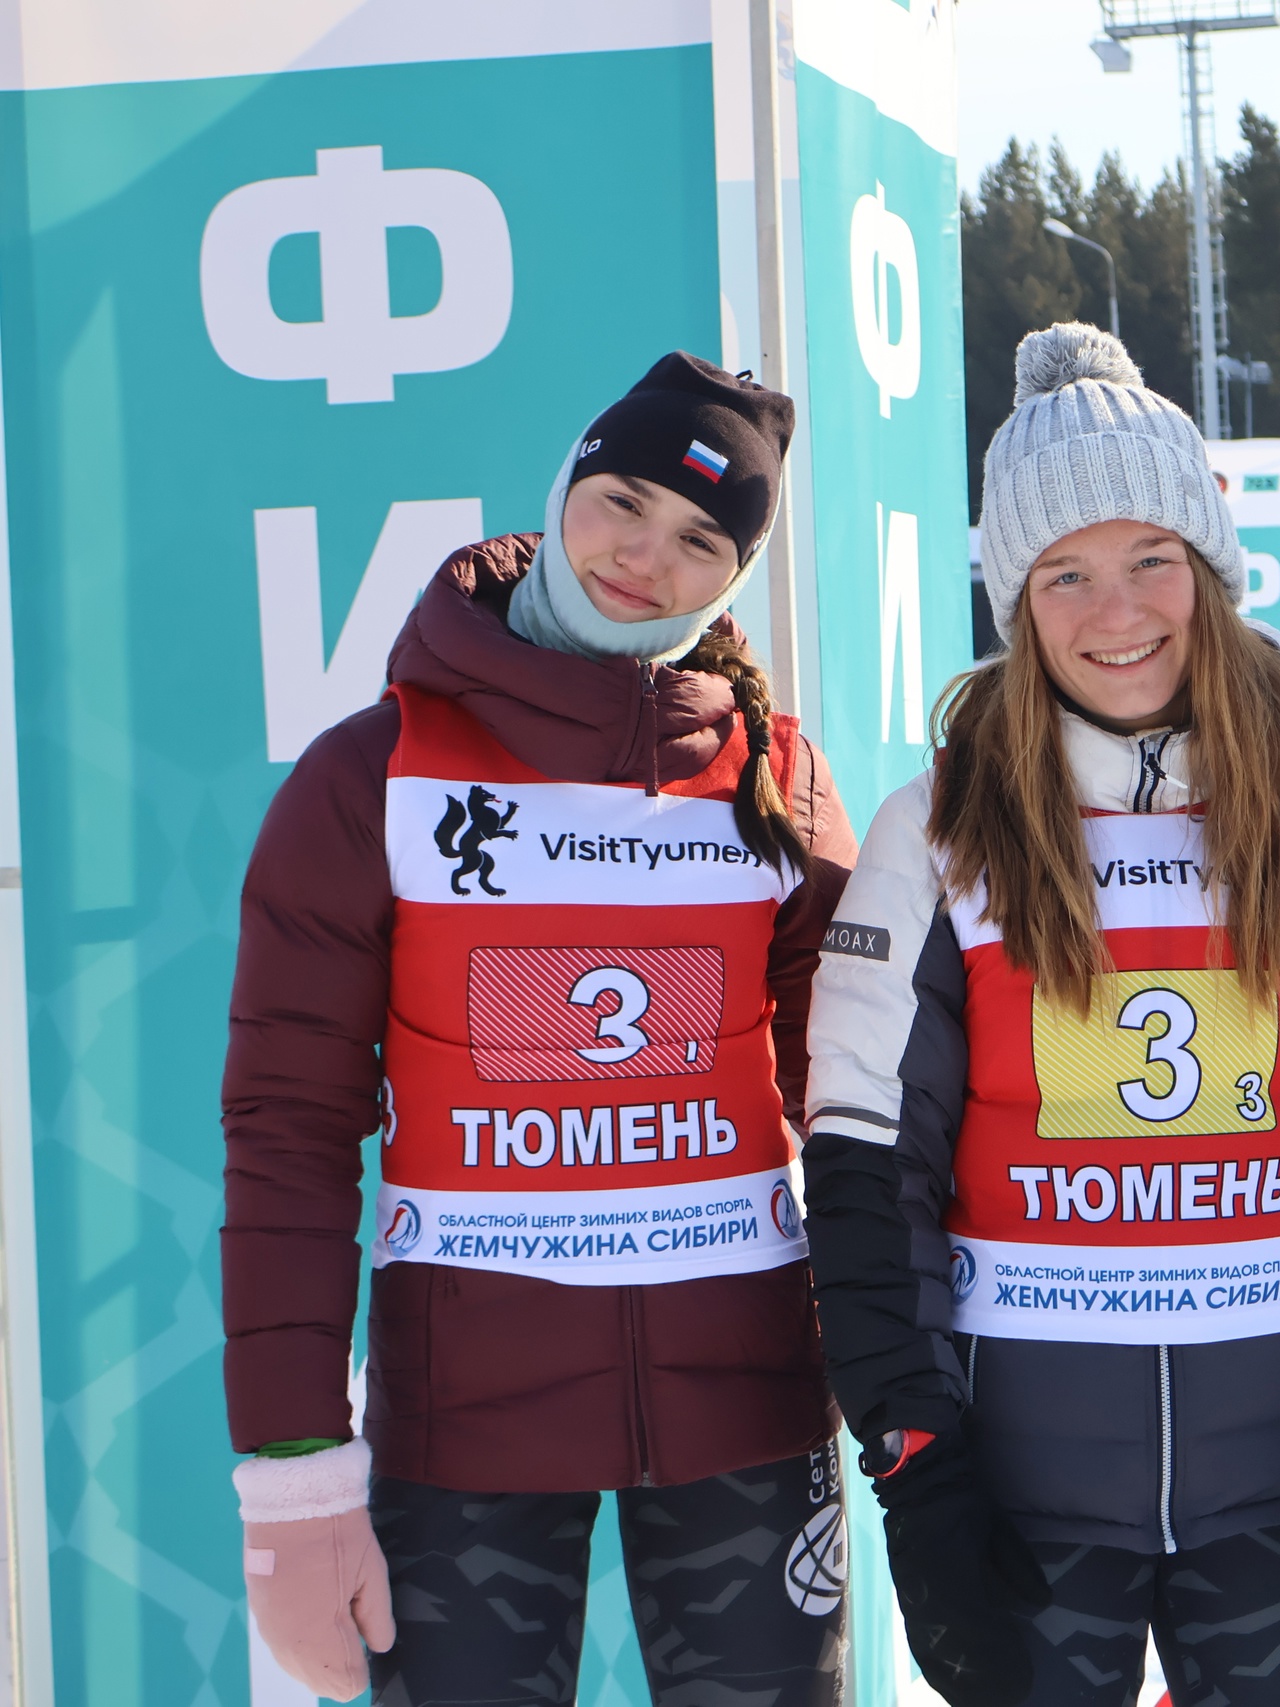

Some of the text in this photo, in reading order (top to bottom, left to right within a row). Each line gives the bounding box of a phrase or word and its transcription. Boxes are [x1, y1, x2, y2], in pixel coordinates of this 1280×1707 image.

[540, 832, 762, 870] VisitTyumen
[1091, 858, 1214, 893] VisitTy
[823, 928, 876, 952] MOAX
[567, 965, 650, 1064] 3
[1116, 987, 1267, 1122] 3 3
[451, 1098, 738, 1168] ТЮМЕНЬ
[438, 1197, 754, 1230] ОБЛАСТНОЙ ЦЕНТР ЗИМНИХ ВИДОВ СПОРТА
[434, 1216, 758, 1259] ЖЕМЧУЖИНА СИБИРИ
[994, 1264, 1084, 1282] ОБЛАСТНОЙ
[1089, 1269, 1135, 1283] ЦЕНТР
[1138, 1267, 1207, 1282] ЗИМНИХ
[1210, 1263, 1260, 1280] ВИДОВ
[994, 1282, 1198, 1312] ЖЕМЧУЖИНА
